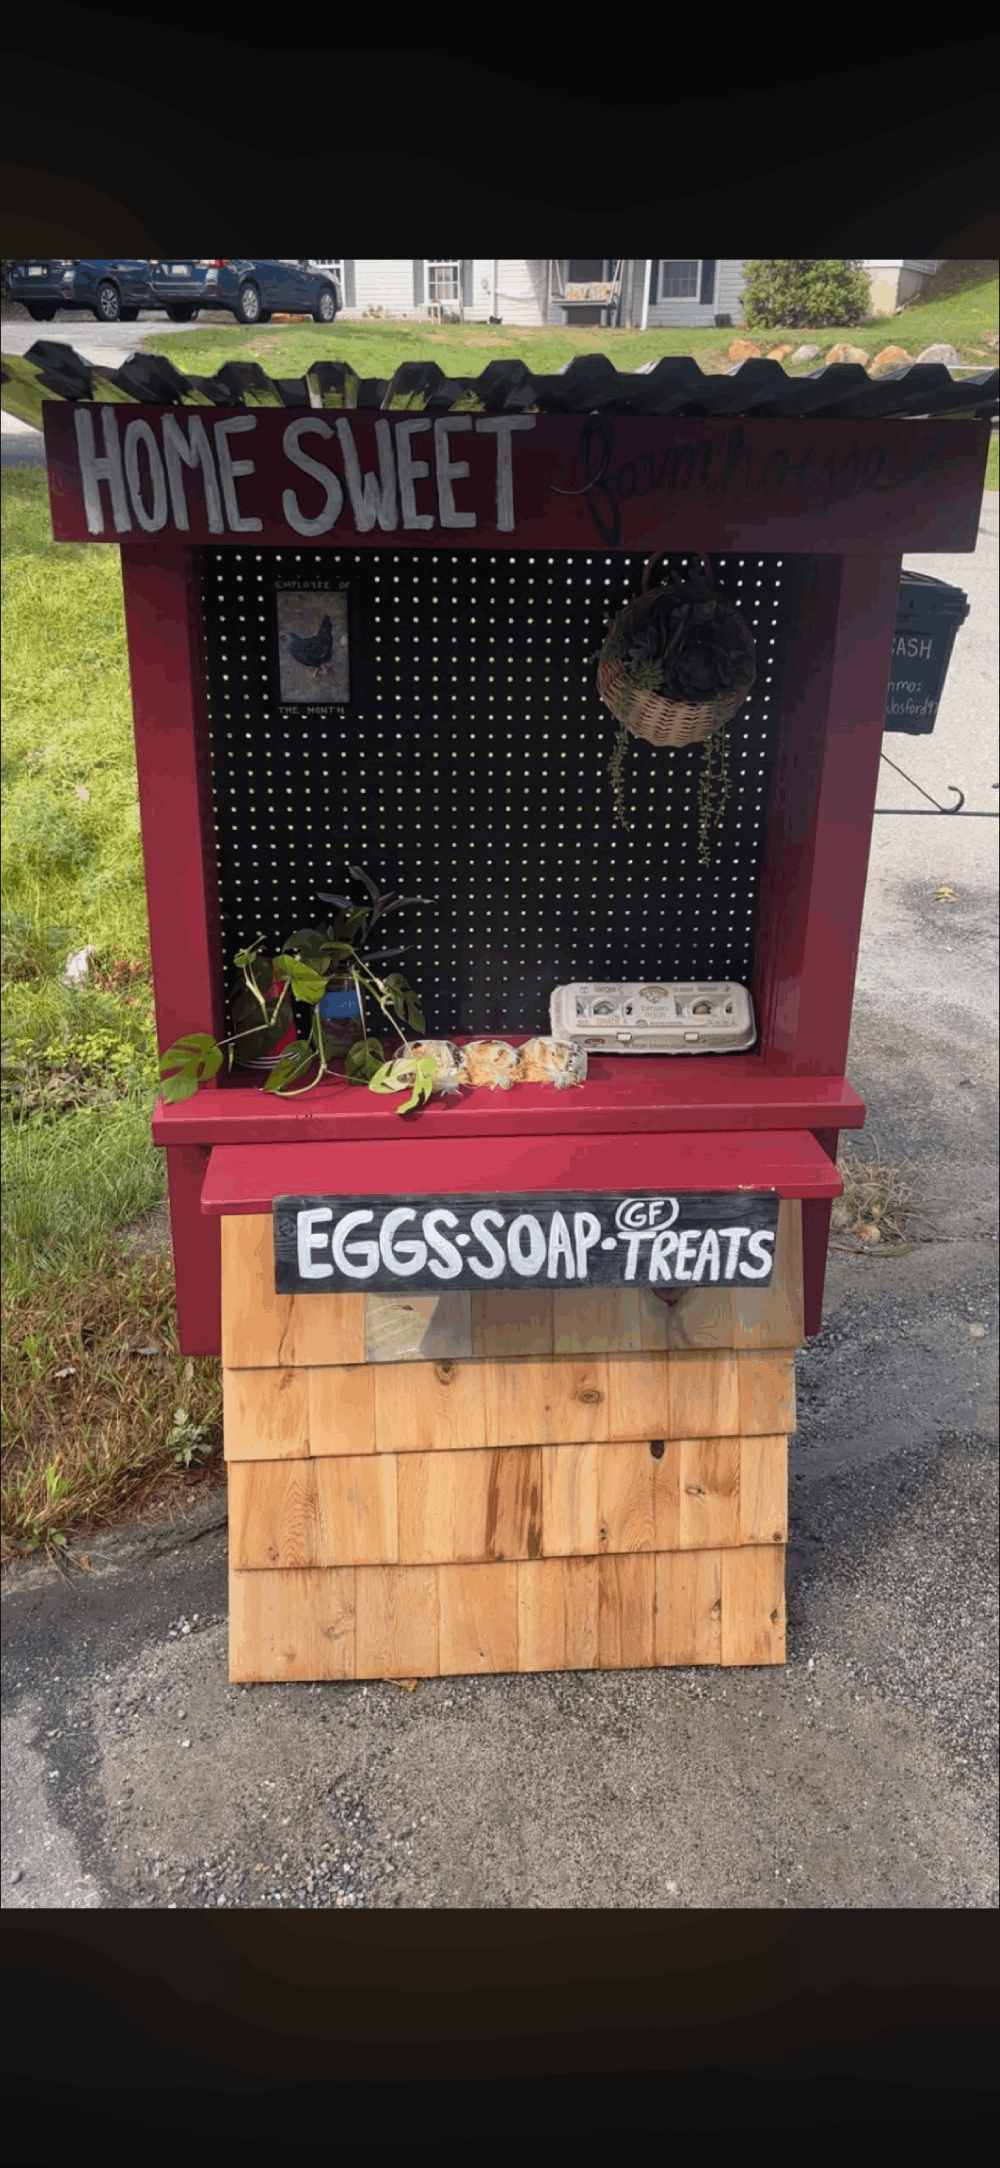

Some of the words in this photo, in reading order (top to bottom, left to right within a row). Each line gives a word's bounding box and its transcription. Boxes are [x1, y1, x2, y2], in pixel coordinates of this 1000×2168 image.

[74, 406, 262, 534] HOME
[282, 415, 536, 536] SWEET
[549, 415, 951, 546] farmhouse
[274, 579, 331, 590] EMPLOYEE
[338, 580, 352, 590] OF
[278, 706, 299, 716] THE
[307, 706, 345, 716] MONTH
[624, 1201, 665, 1226] GF
[616, 1227, 775, 1282] TREATS
